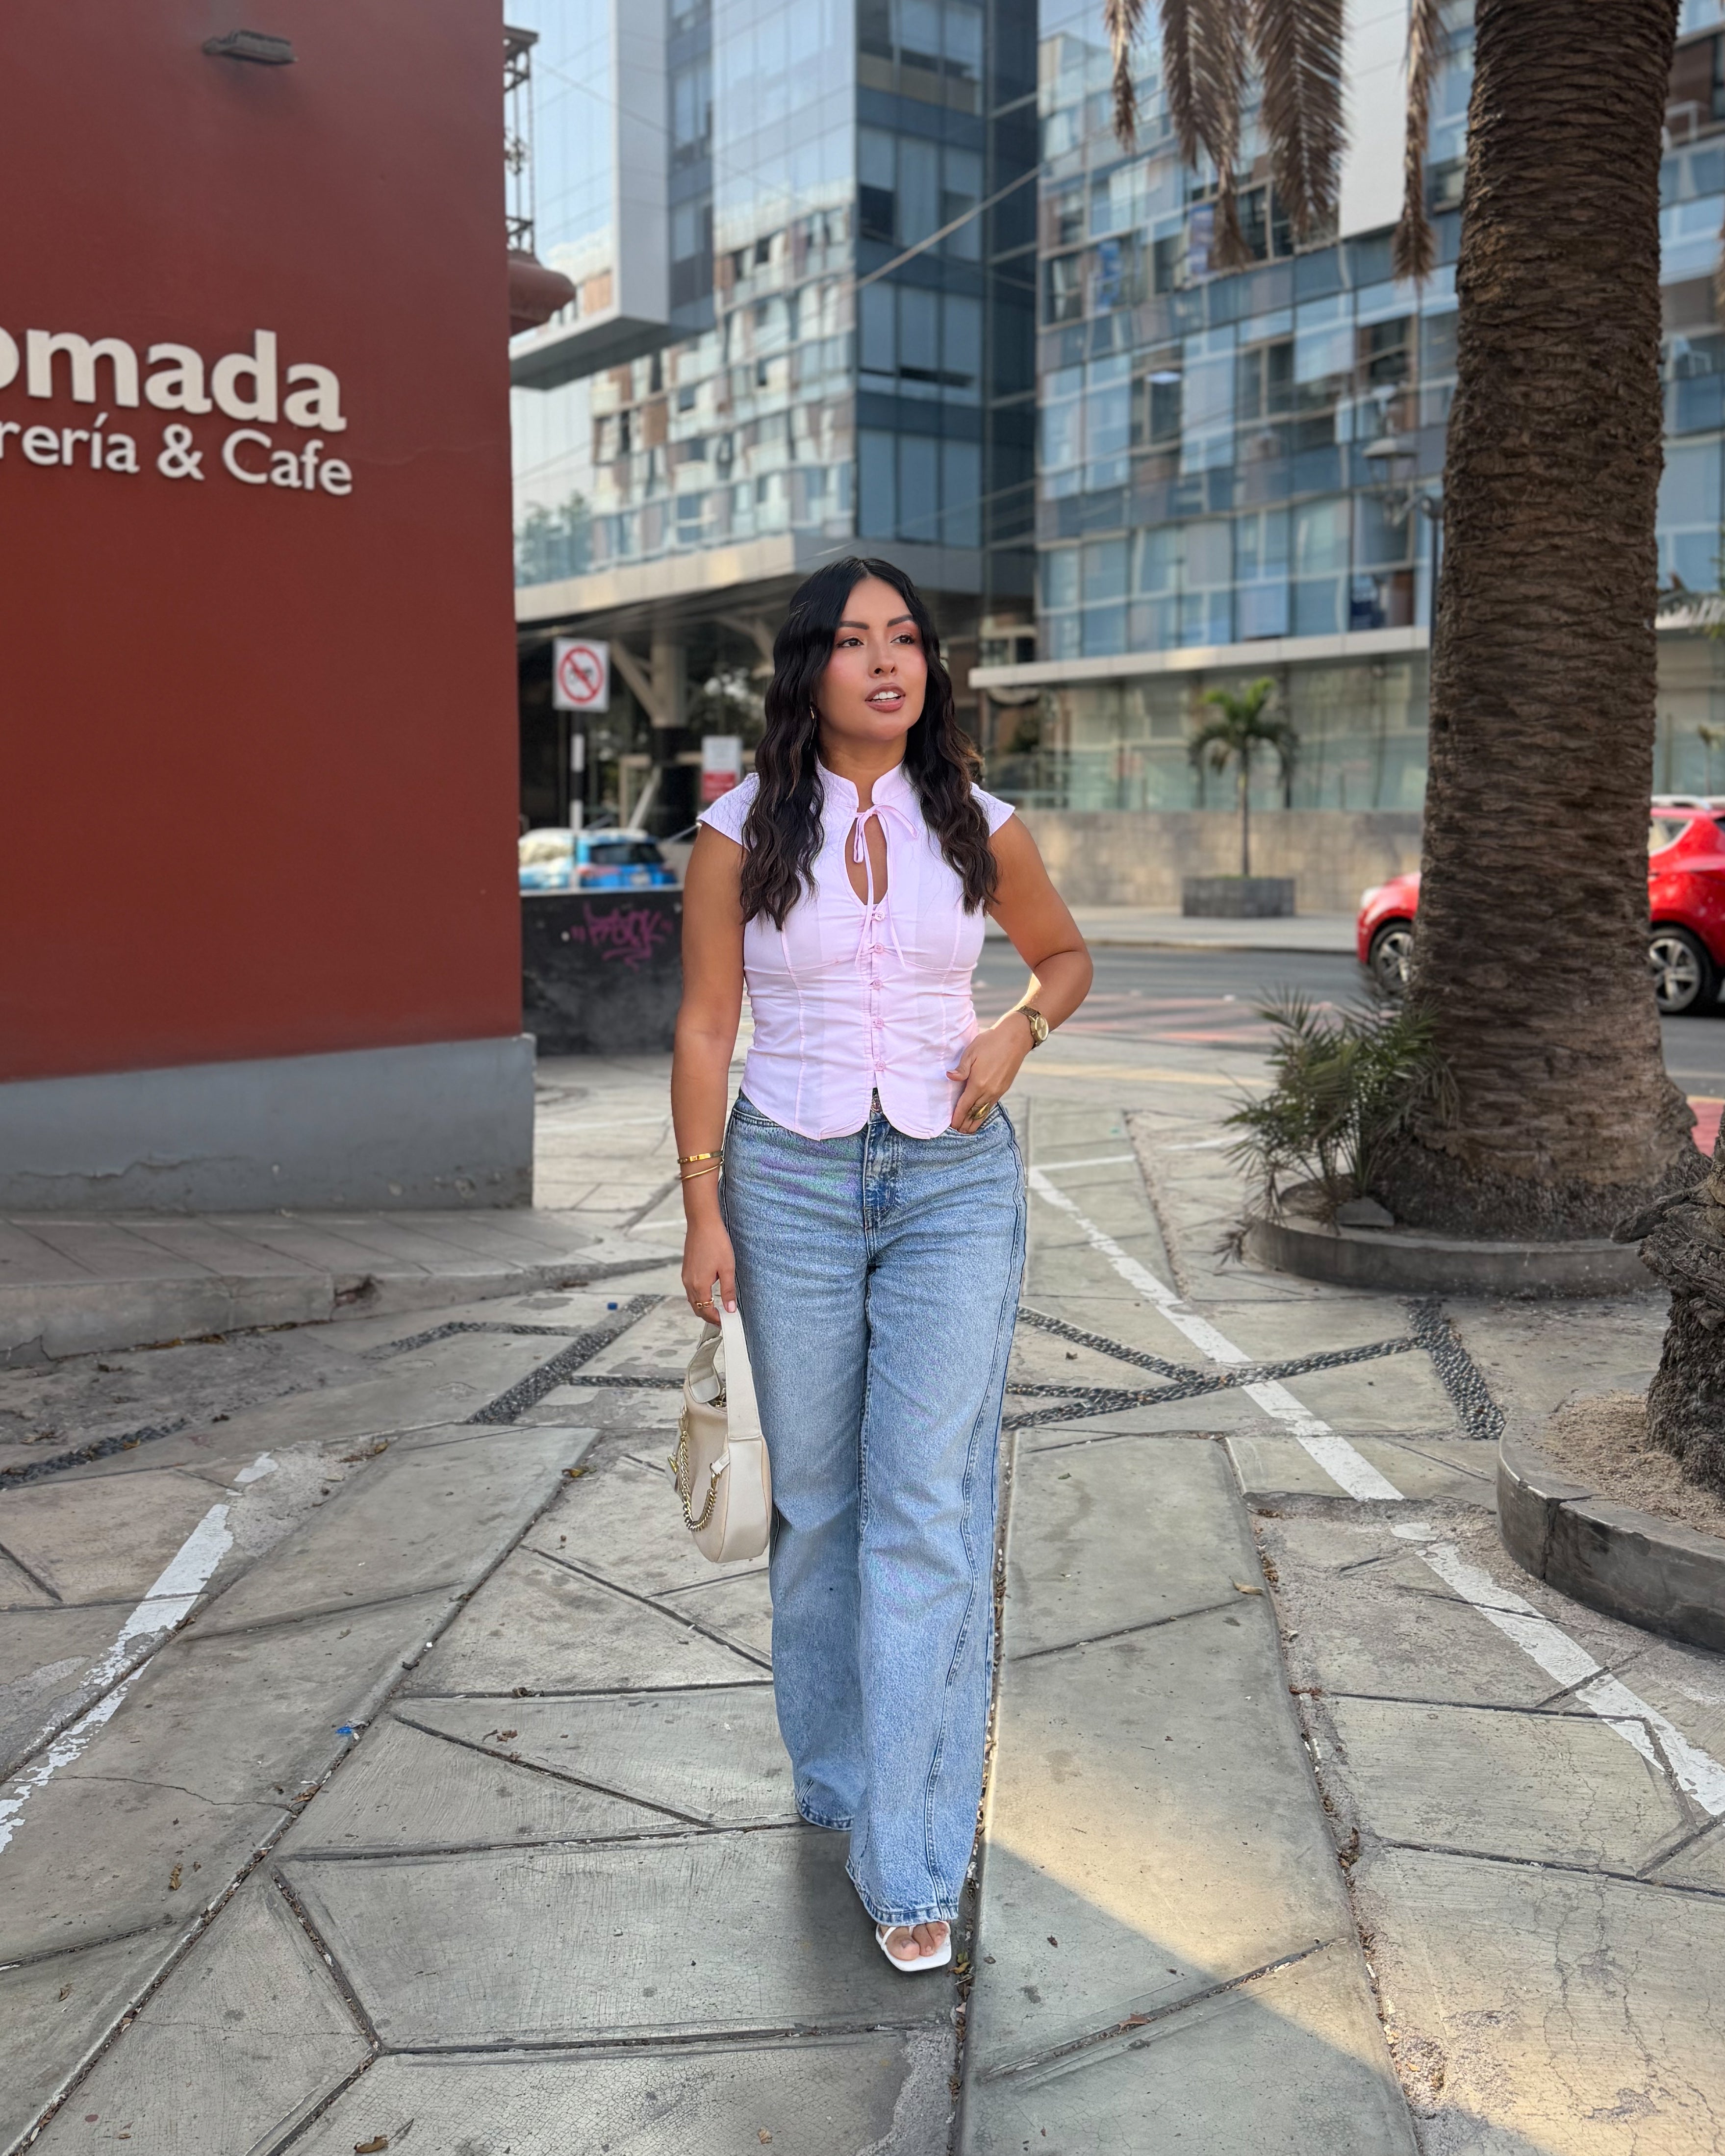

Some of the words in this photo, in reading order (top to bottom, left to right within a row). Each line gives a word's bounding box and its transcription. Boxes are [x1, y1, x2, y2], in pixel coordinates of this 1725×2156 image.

[0, 327, 347, 432] mada
[157, 424, 204, 480] &
[222, 429, 352, 495] Cafe
